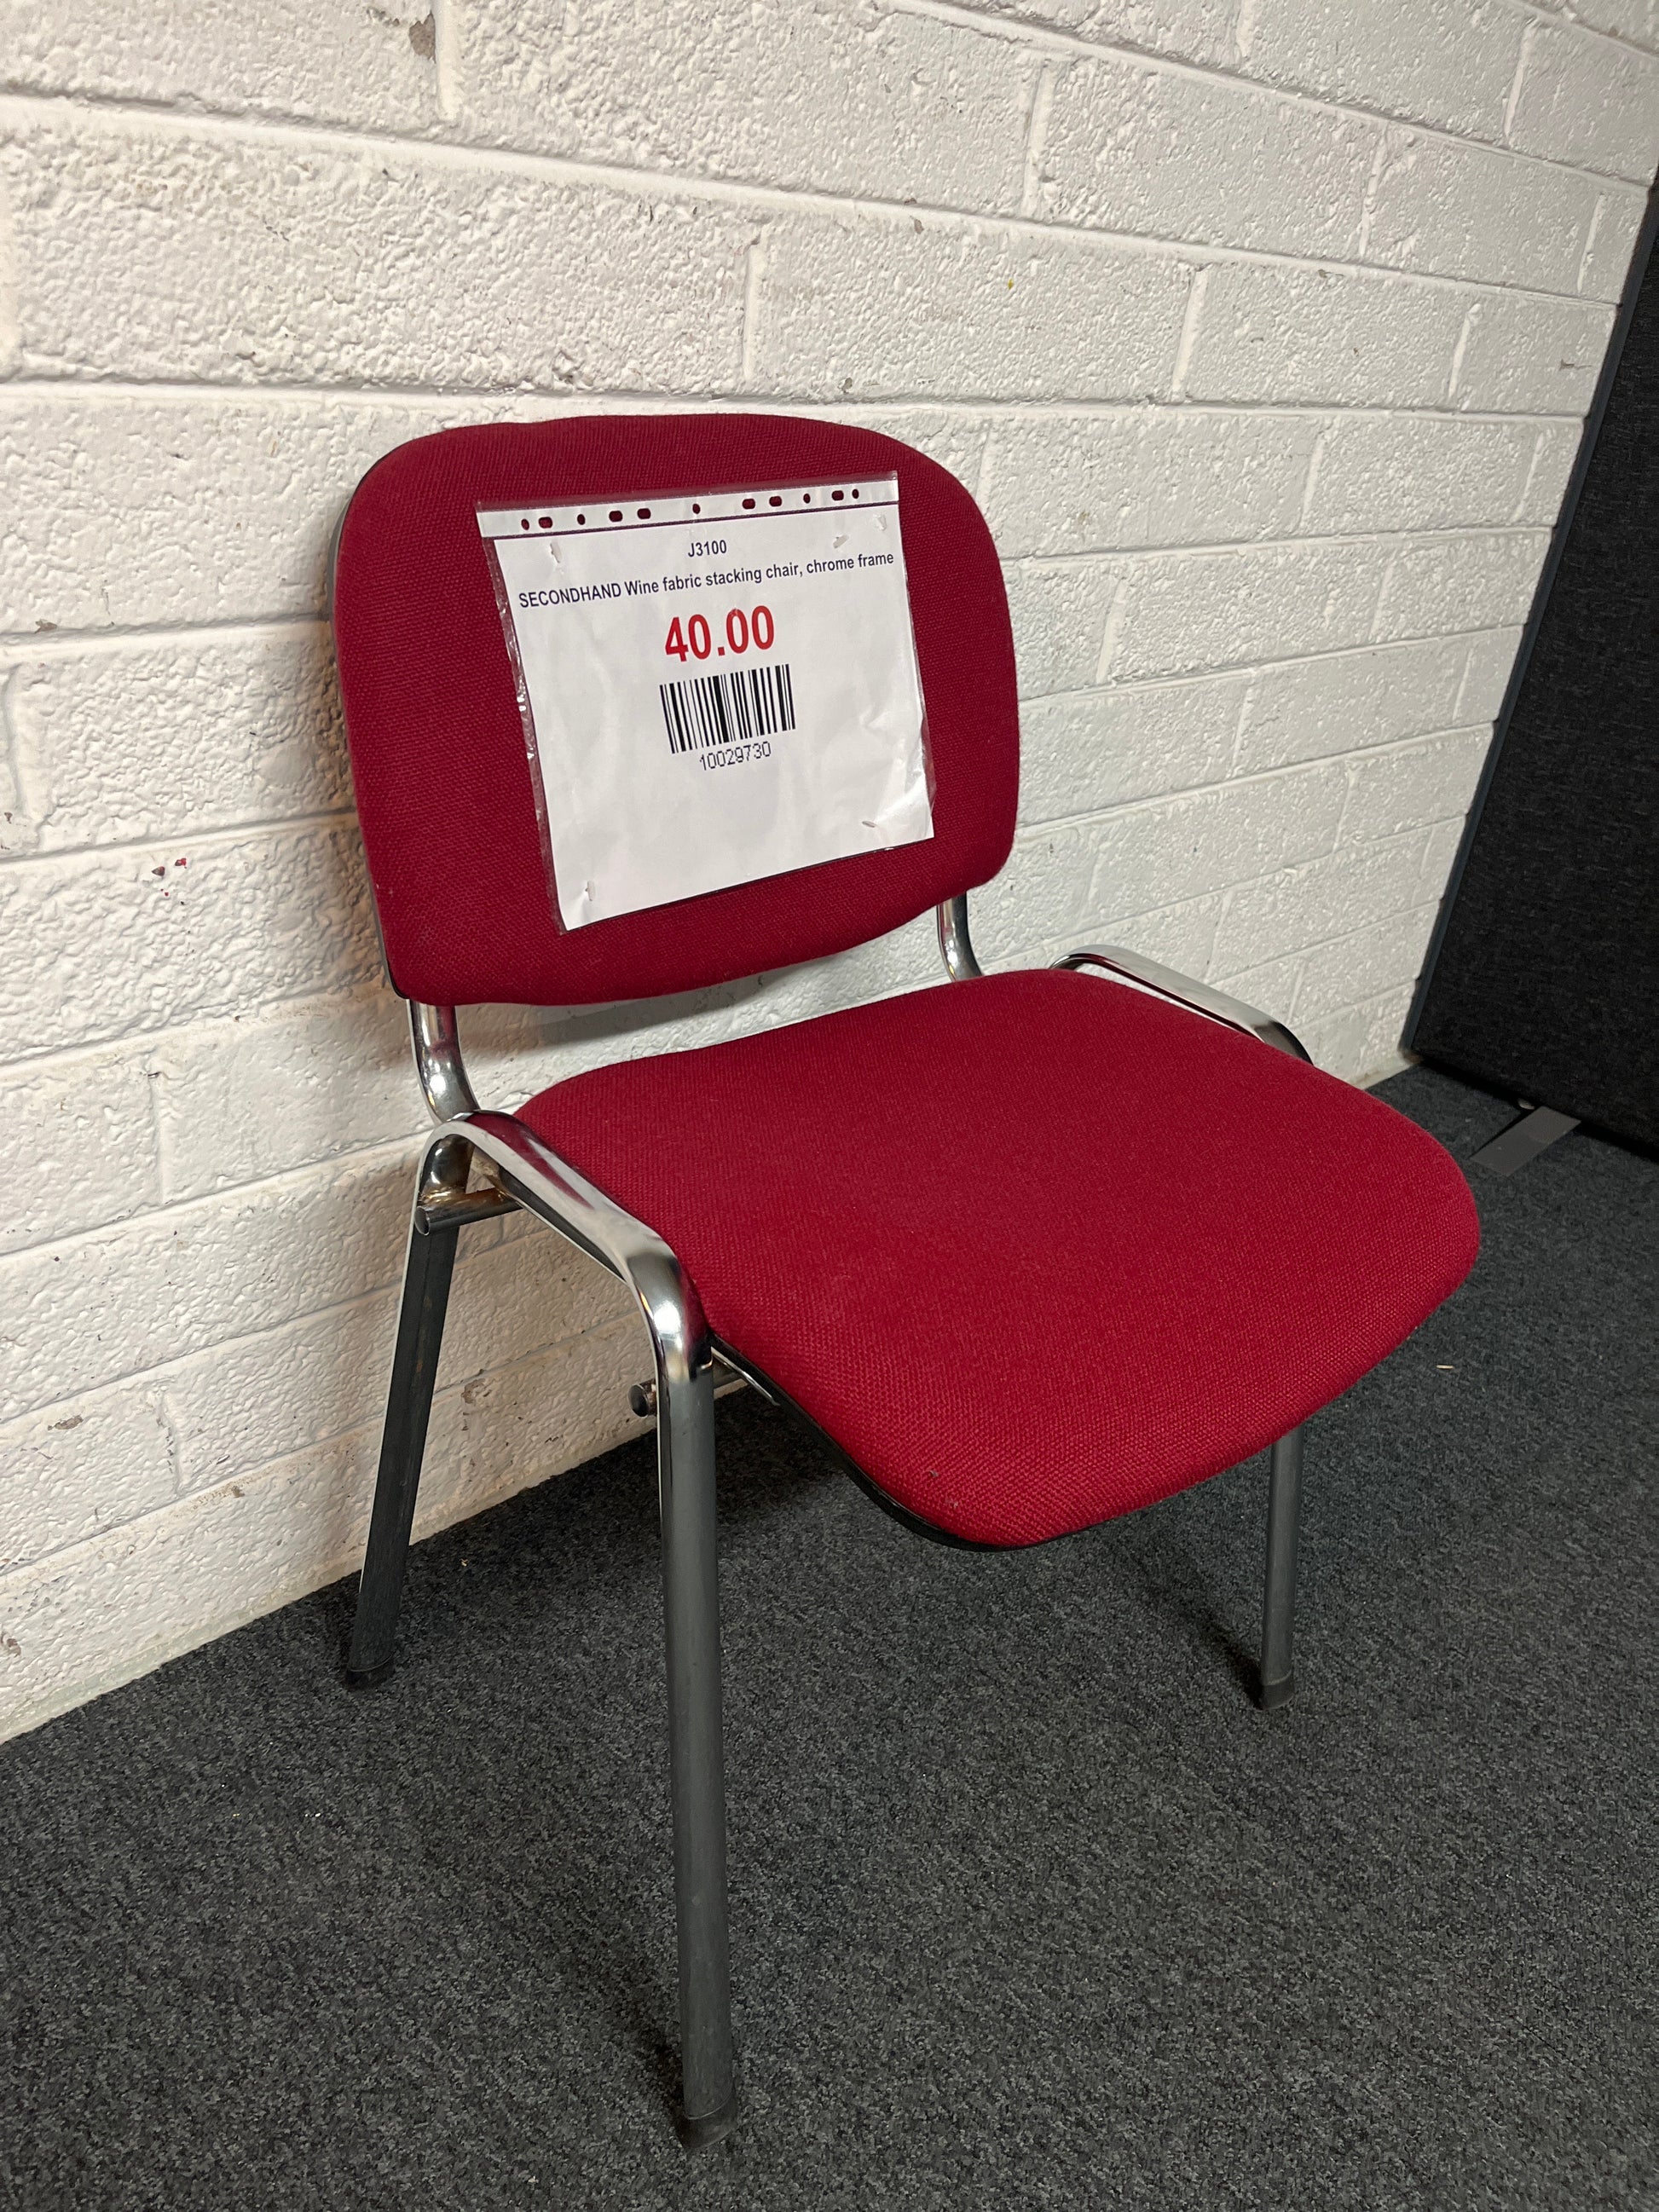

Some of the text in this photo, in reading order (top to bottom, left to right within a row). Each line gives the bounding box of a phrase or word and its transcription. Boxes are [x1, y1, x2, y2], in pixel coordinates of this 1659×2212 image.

[687, 540, 727, 557] J3100
[518, 550, 894, 609] SECONDHAND Wine fabric stacking chair, chrome frame
[664, 605, 775, 662] 40.00
[699, 741, 772, 771] 10029730
